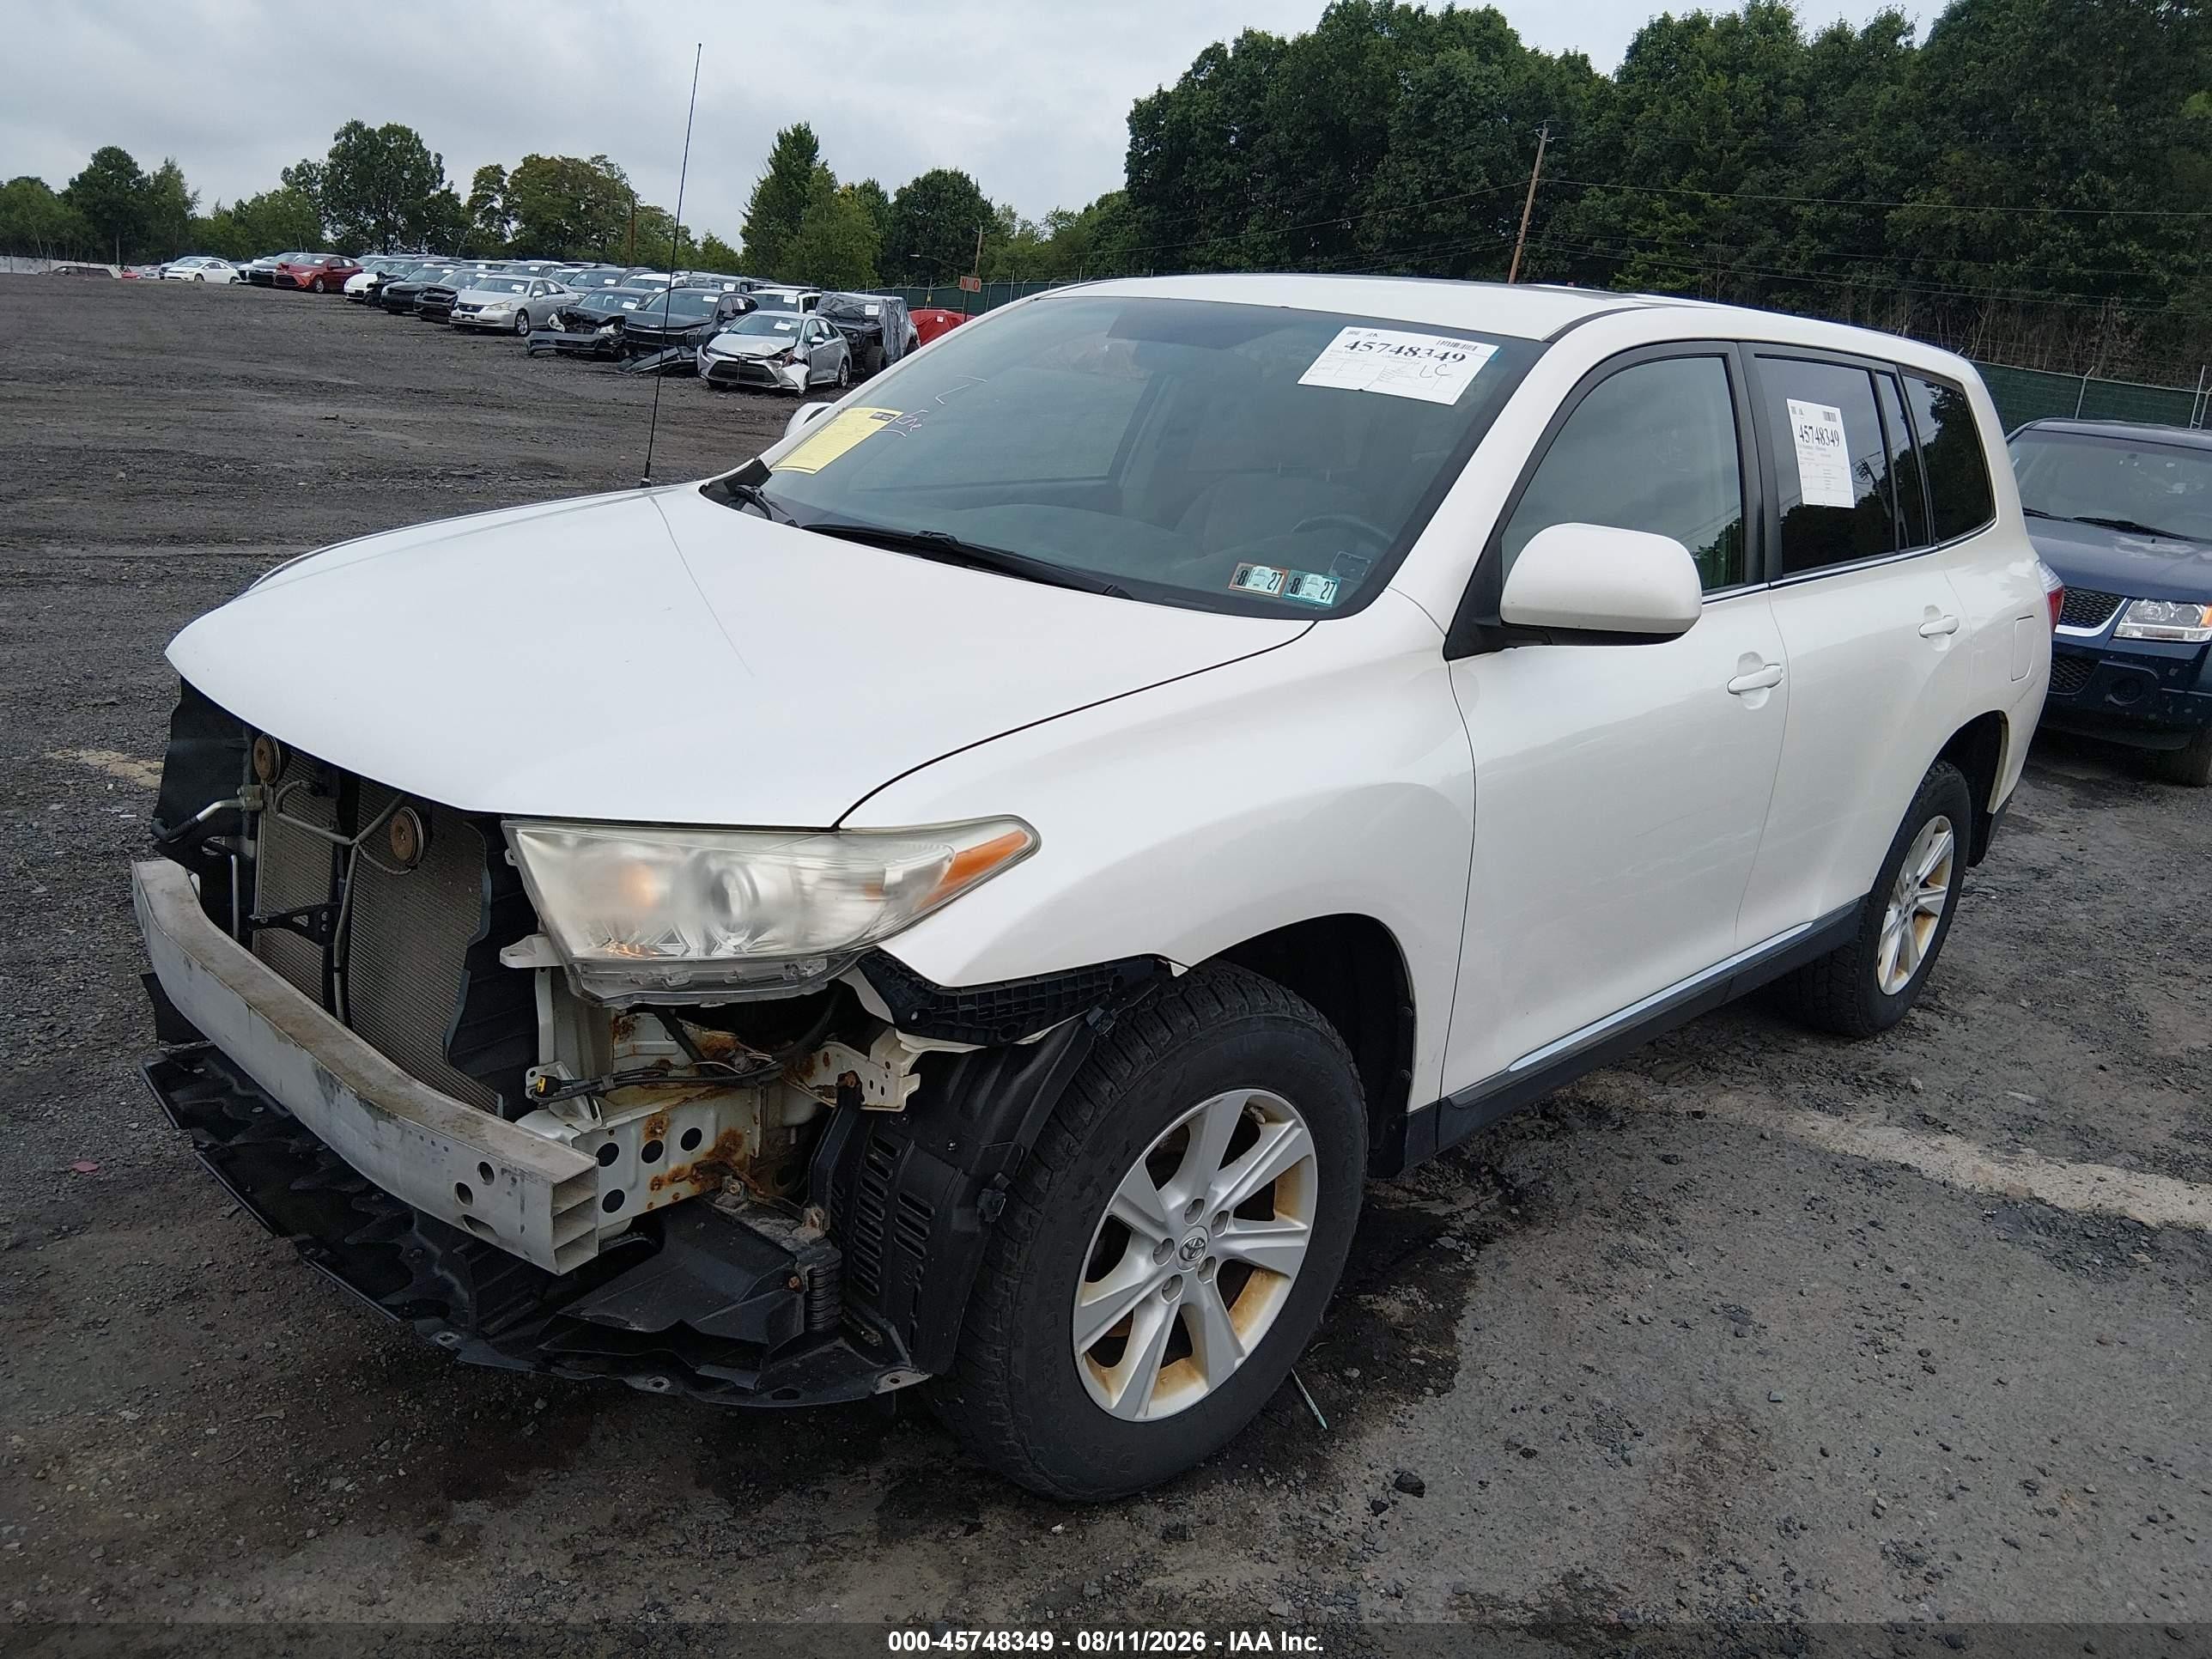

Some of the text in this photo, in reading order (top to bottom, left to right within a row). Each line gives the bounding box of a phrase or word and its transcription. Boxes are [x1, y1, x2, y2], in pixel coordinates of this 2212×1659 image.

[1344, 340, 1467, 363] 45748349
[1799, 423, 1840, 447] 45748349
[1267, 572, 1284, 592] 27
[1320, 580, 1337, 602] 27
